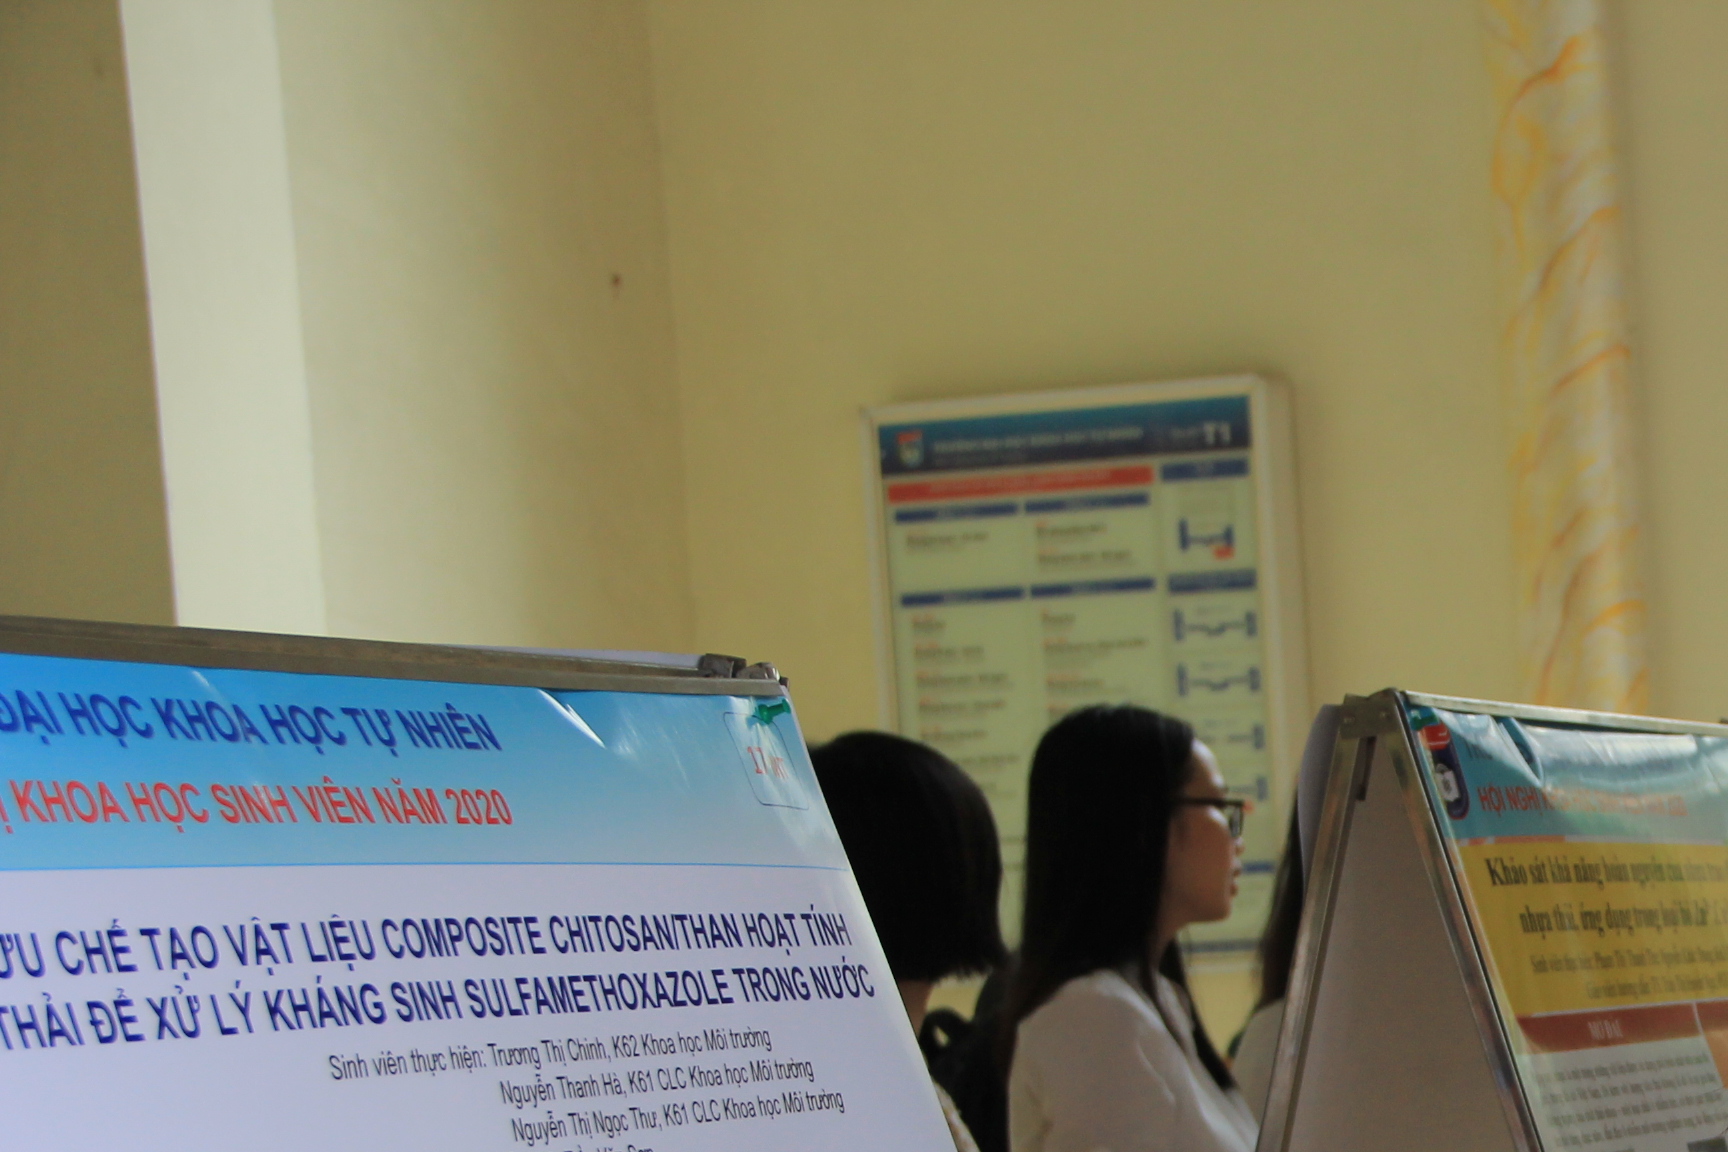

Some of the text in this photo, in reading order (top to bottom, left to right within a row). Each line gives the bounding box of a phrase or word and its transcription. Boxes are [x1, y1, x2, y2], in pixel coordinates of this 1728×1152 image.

[56, 691, 154, 748] HỌC
[149, 696, 269, 745] KHOA
[259, 703, 347, 755] HỌC
[338, 706, 398, 757] TỰ
[393, 701, 502, 751] NHIÊN
[8, 779, 130, 824] KHOA
[124, 781, 209, 833] HỌC
[209, 783, 298, 824] SINH
[290, 784, 376, 824] VIÊN
[370, 777, 448, 824] NĂM
[443, 787, 513, 825] 2020
[53, 918, 138, 976] CHẾ
[137, 924, 219, 981] TẠO
[221, 915, 293, 976] VẬT
[299, 913, 376, 971] LIỆU
[380, 915, 547, 959] COMPOSITE
[548, 912, 743, 954] CHITOSAN/THAN
[740, 911, 800, 956] HOẠT
[799, 903, 852, 946] TÍNH
[0, 955, 875, 1050] THẢI ĐỂ XỬ LÝ KHÁNG SINH SULFAMETHOXAZOLE TRONG NƯỚC
[327, 1025, 772, 1081] Sinh viên thực hiện: Trương Thị Chinh, K62 Khoa học Môi trường
[498, 1057, 815, 1110] Nguyễn Thanh Hà, K61 CLC Khoa học Môi trường
[509, 1088, 845, 1147] Nguyễn Thị Ngọc Thư, K61 CLC Khoa học Môi trường
